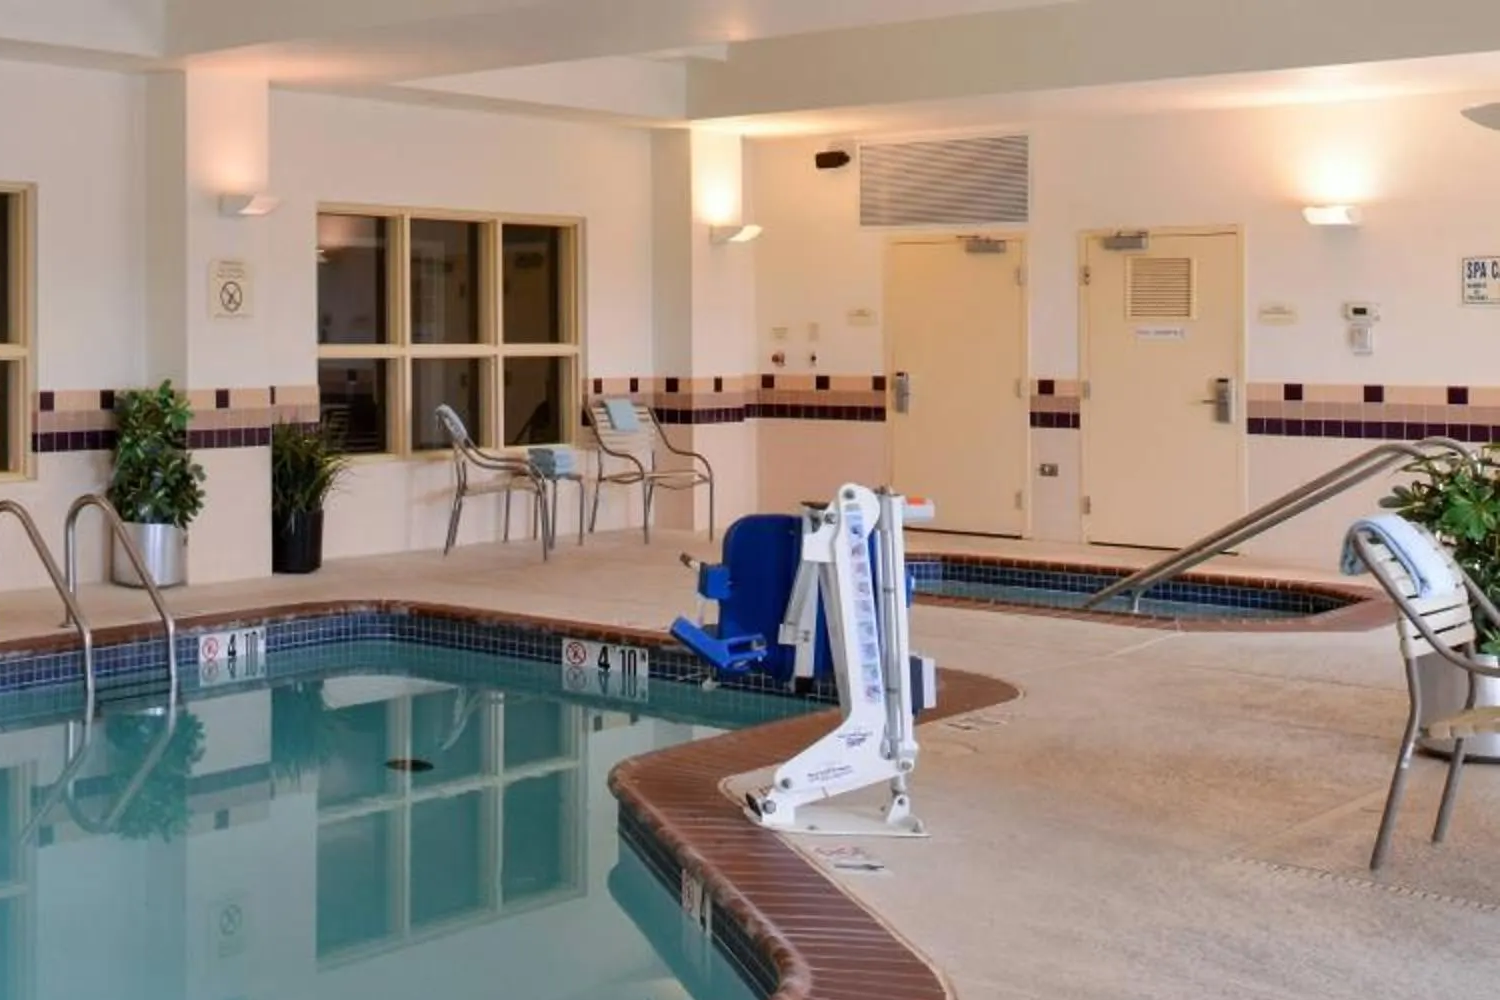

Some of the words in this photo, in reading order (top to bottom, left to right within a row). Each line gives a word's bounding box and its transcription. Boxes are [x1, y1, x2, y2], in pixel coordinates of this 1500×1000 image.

[1467, 261, 1487, 279] SPA
[1491, 260, 1500, 280] C
[227, 633, 237, 656] 4
[598, 645, 610, 670] 4
[620, 649, 637, 675] 10
